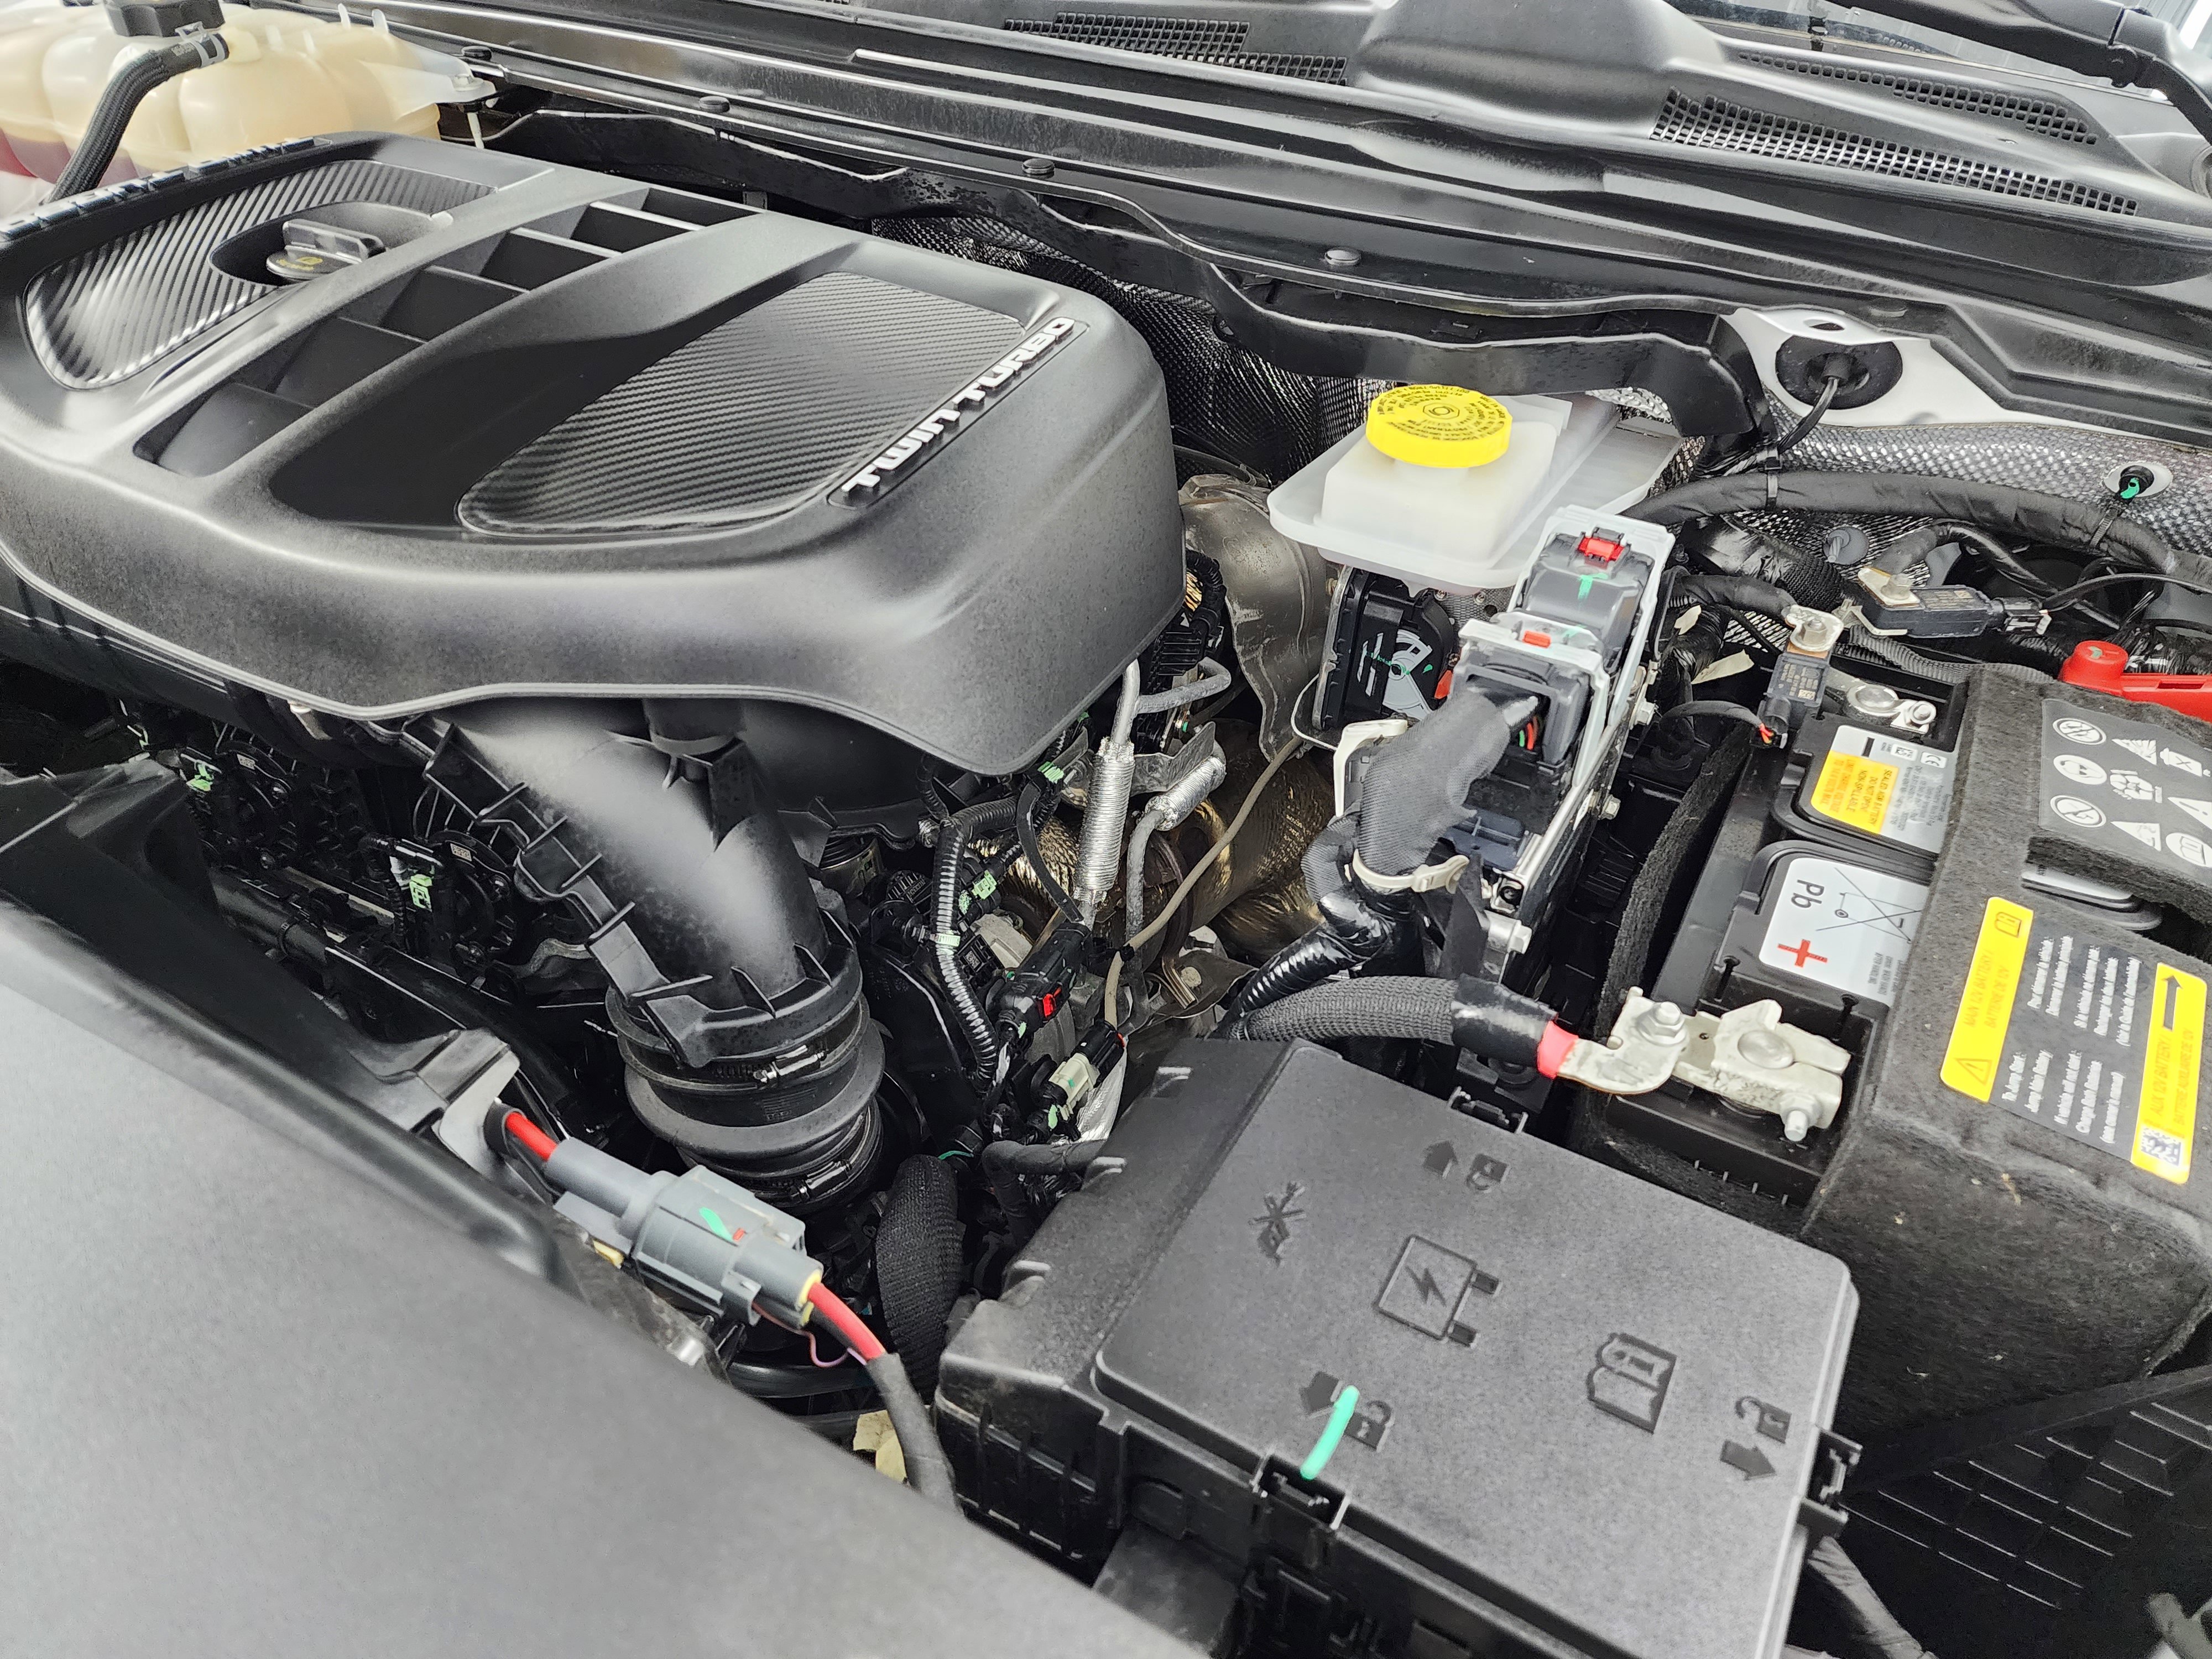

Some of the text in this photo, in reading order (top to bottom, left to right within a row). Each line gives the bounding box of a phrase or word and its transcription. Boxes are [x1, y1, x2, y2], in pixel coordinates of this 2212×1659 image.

[841, 317, 1075, 493] TWIN TURBO
[1846, 770, 1867, 812] NON-SPILLABLE
[1866, 785, 1875, 796] NOT
[1869, 770, 1892, 826] SEALED AGM BATTERY
[1860, 796, 1872, 812] OPEN
[1791, 879, 1825, 909] Pb
[1973, 953, 1991, 989] BATTERY
[1970, 989, 1983, 1004] 12V
[1984, 966, 2009, 1029] BATTERIE DE 12V
[1963, 1006, 1979, 1027] MAIN
[2032, 1050, 2054, 1075] Battery
[2154, 1040, 2170, 1078] BATTERY
[2005, 1073, 2025, 1093] Jump
[2084, 1061, 2103, 1091] Batteries
[2153, 1076, 2167, 1094] 12V
[2001, 1092, 2018, 1102] To
[2025, 1091, 2044, 1113] Jump
[2150, 1094, 2165, 1116] AUX
[2173, 1088, 2188, 1125] BATTERIE
